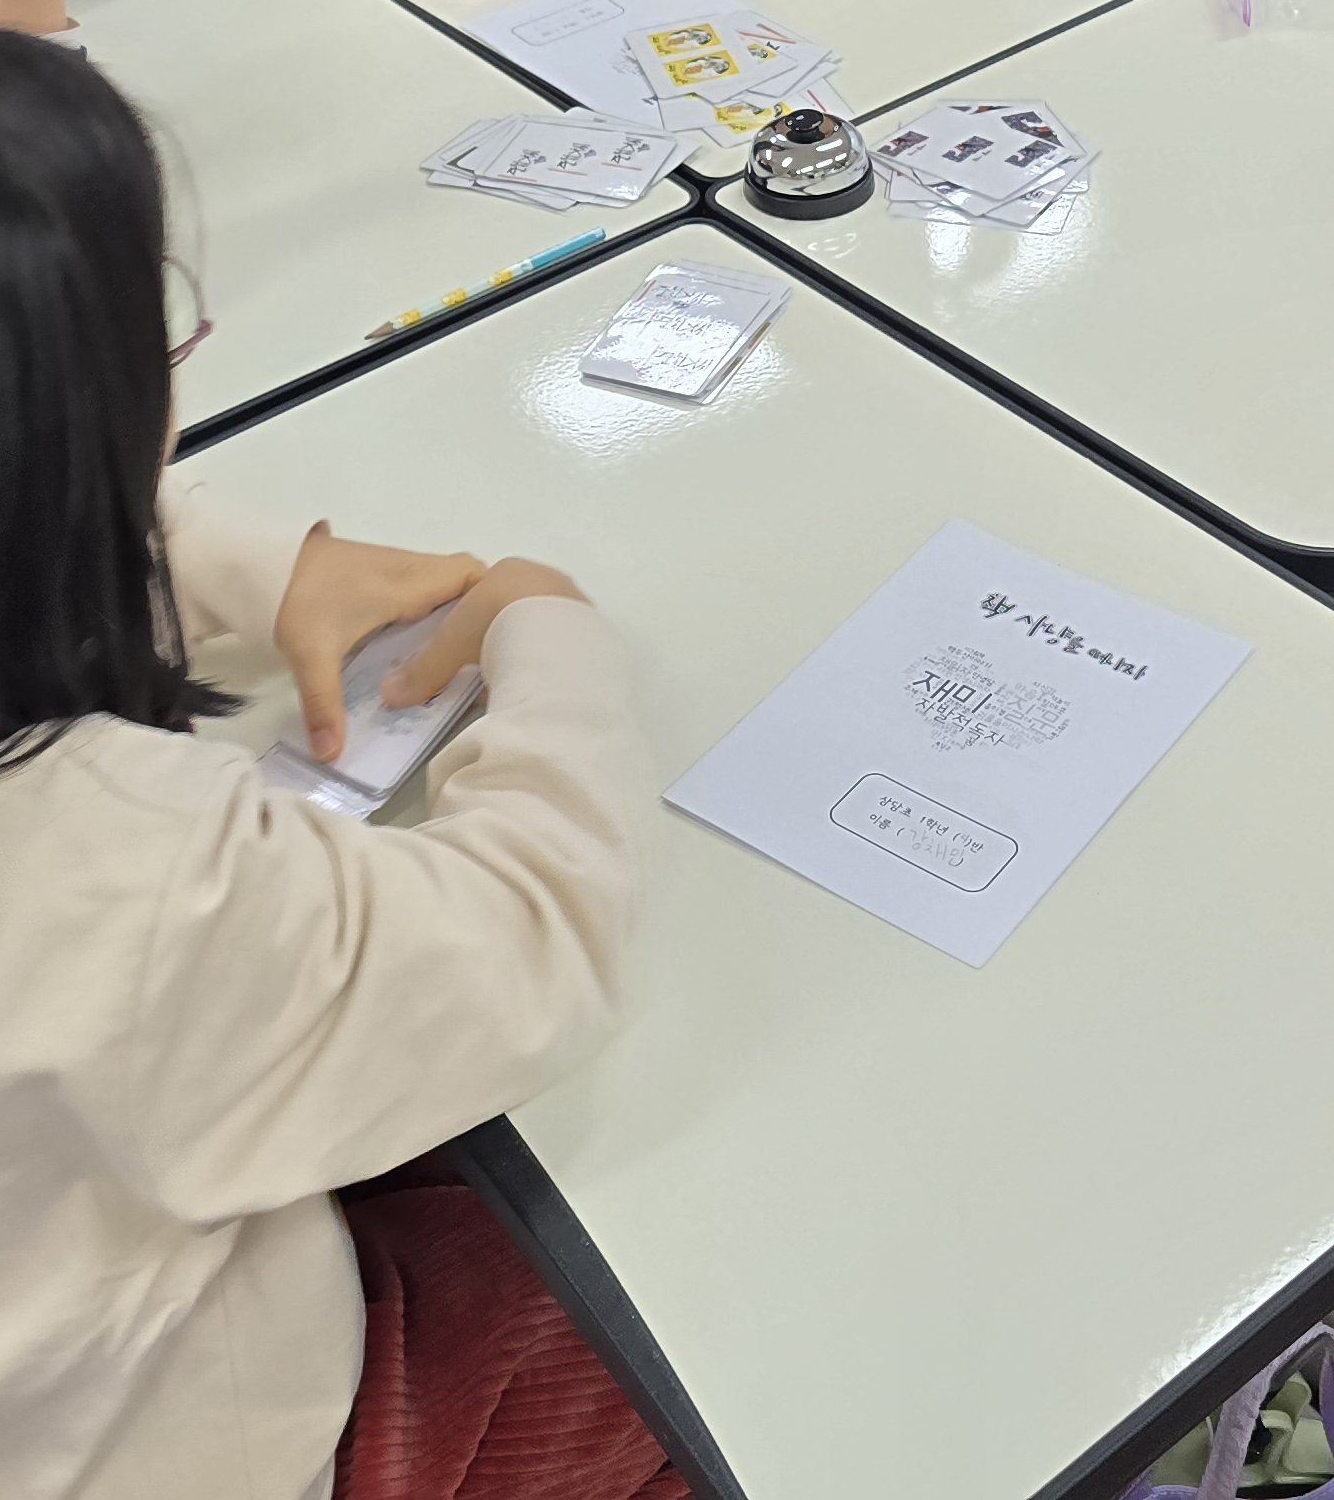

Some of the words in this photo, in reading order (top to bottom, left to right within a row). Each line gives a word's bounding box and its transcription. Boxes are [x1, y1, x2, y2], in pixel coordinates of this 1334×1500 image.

[912, 669, 993, 715] 재미
[914, 697, 1007, 748] 자발적독자
[869, 812, 893, 830] 이름
[878, 795, 913, 818] 상당초
[919, 815, 950, 837] 1학년
